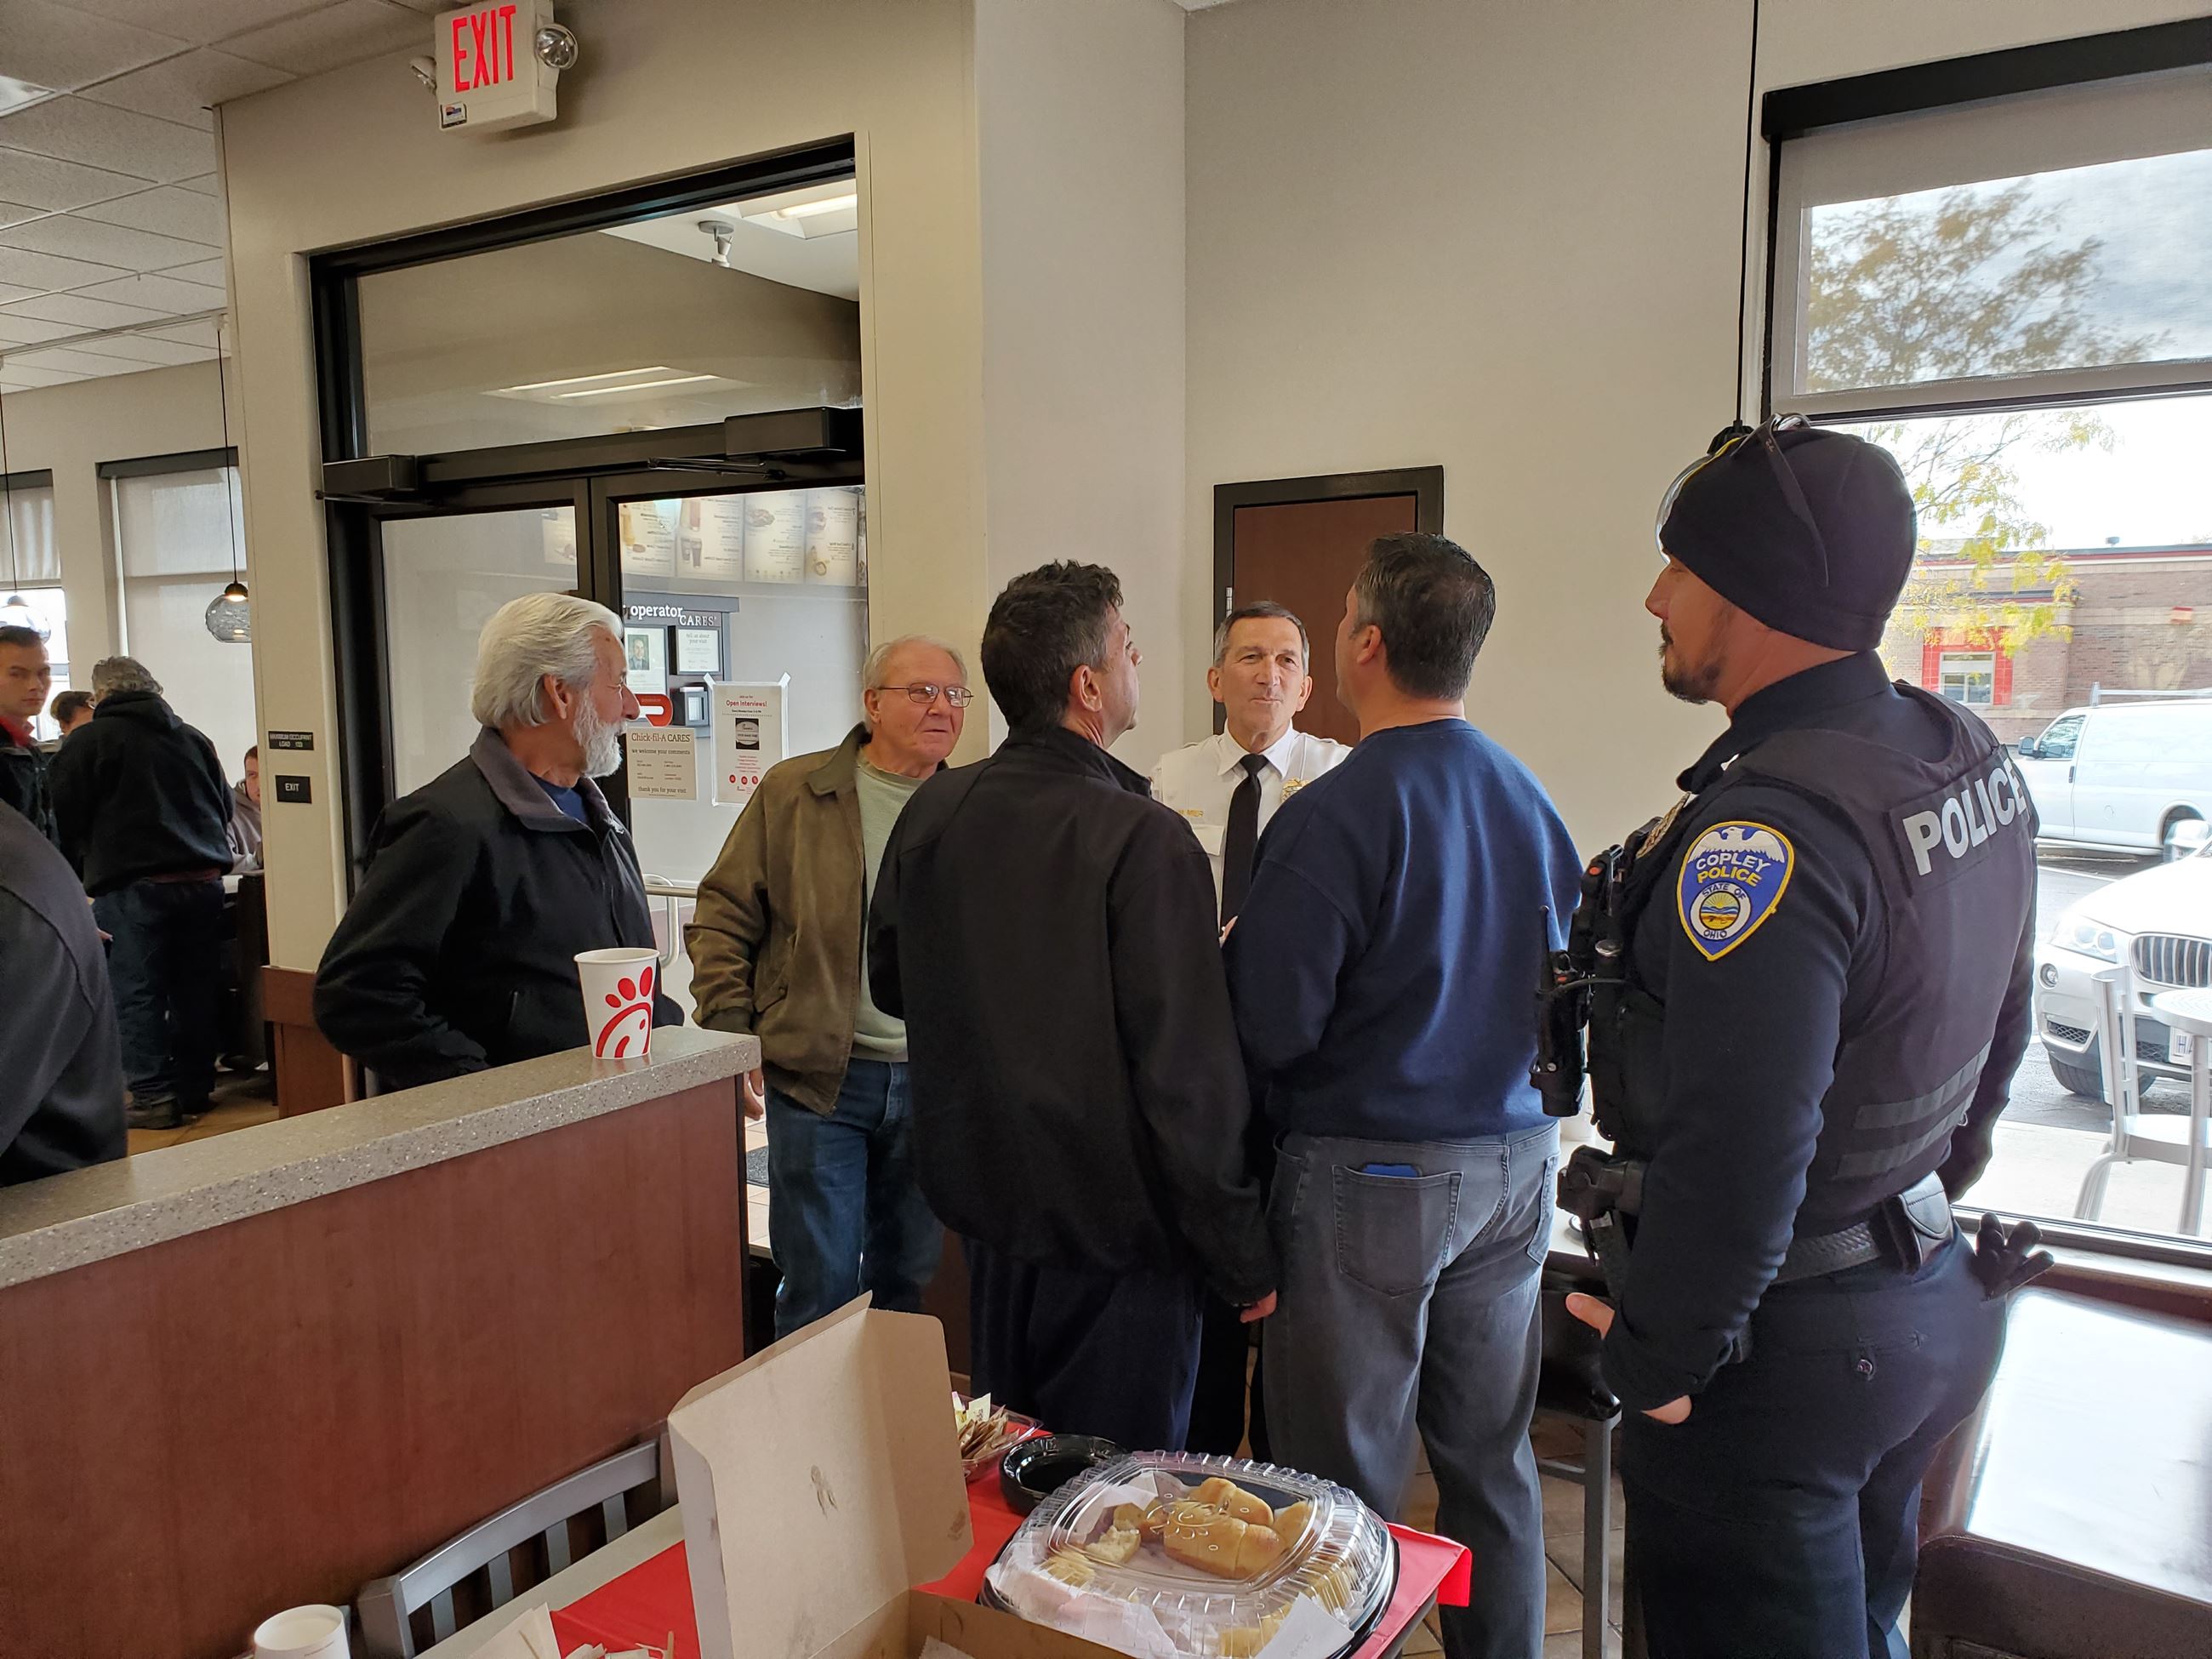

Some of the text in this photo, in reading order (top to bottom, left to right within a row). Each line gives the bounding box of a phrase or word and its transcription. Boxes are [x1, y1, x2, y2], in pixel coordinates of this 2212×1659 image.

[452, 5, 517, 93] EXIT
[630, 604, 683, 620] operator
[679, 614, 715, 626] CARES
[631, 733, 691, 743] Chick-fil-A CARES
[285, 783, 299, 791] EXIT
[1902, 757, 2027, 876] POLICE
[1696, 852, 1771, 872] COPLEY
[1697, 866, 1763, 887] POLICE
[1702, 882, 1747, 900] STATE OF
[1703, 929, 1728, 938] OHIO
